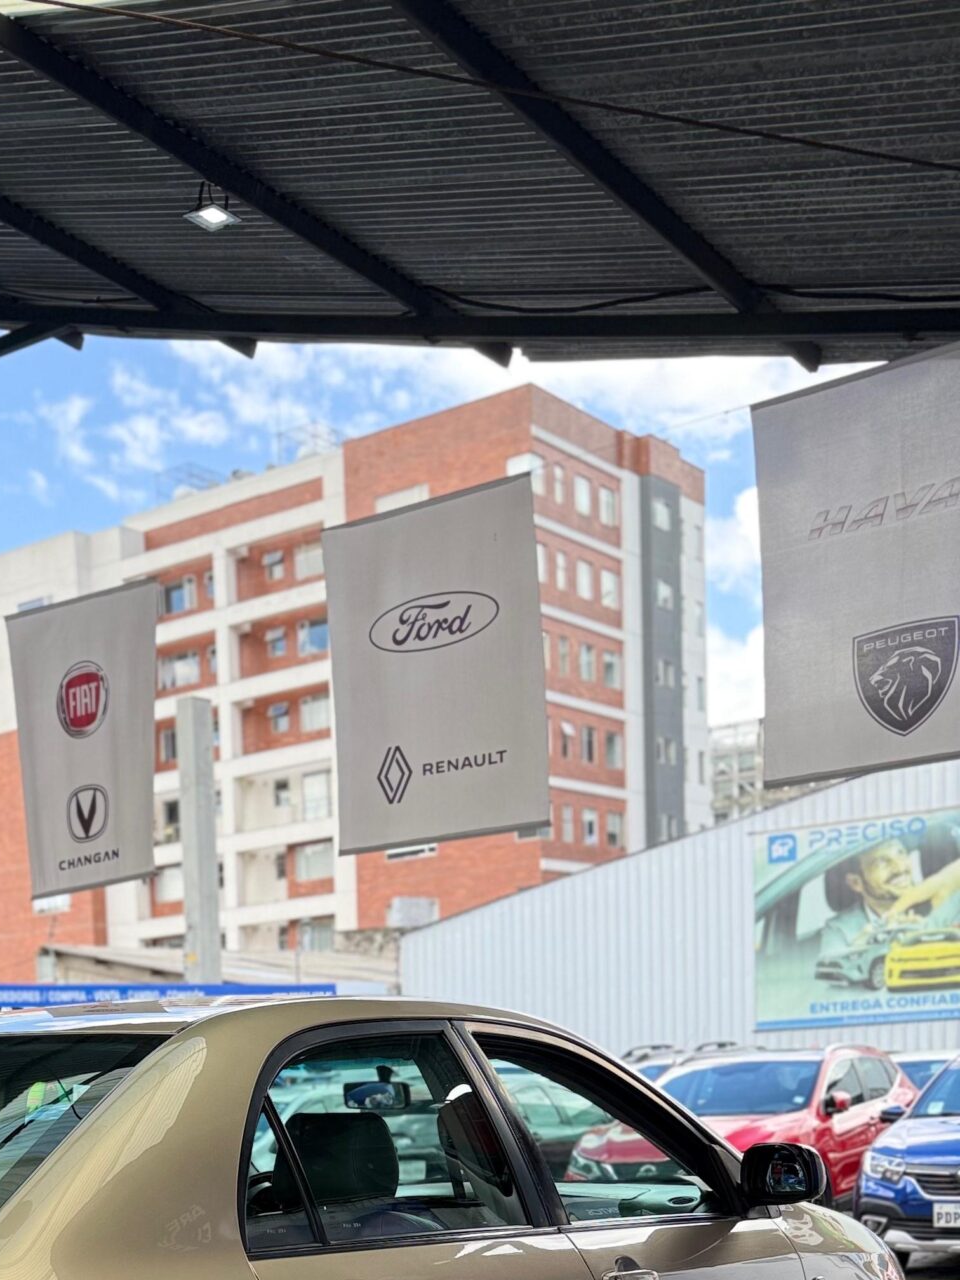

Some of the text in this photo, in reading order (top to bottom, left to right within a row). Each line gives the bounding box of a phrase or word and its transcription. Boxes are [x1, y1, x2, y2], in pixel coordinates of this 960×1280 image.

[391, 600, 473, 646] Ford
[863, 626, 949, 652] PEUGEOT
[68, 680, 98, 720] FIAT
[422, 750, 508, 776] RENAULT
[808, 816, 927, 848] PRECISO
[58, 848, 120, 872] CHANGAN
[810, 998, 883, 1014] ENTREGA
